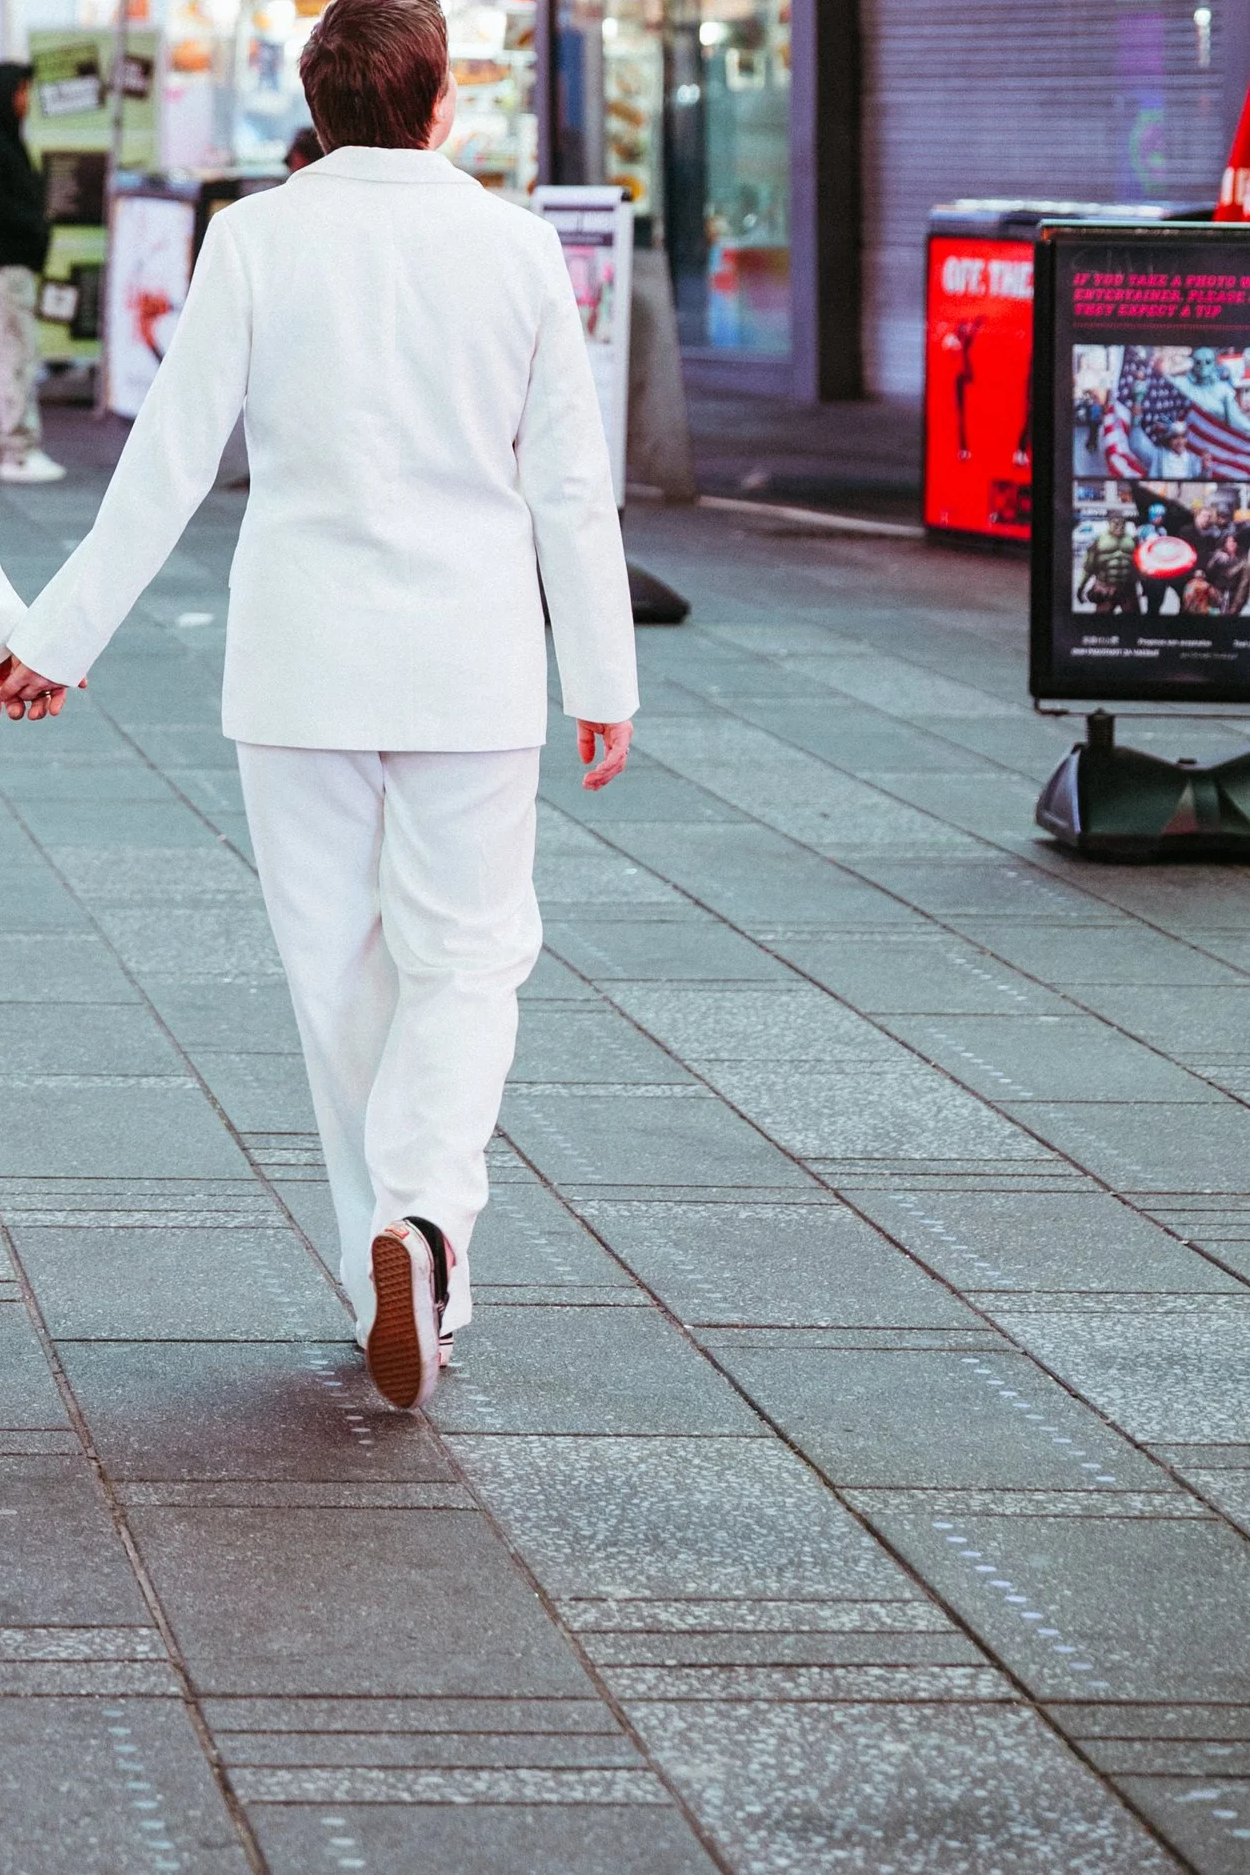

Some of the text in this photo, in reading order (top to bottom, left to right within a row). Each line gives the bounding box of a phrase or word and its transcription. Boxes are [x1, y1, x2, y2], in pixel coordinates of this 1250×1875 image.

[1072, 272, 1090, 286] IF
[1093, 272, 1125, 286] YOU
[1128, 273, 1168, 287] TAKE
[1170, 273, 1182, 288] A
[1184, 274, 1236, 289] PHOTO
[1186, 289, 1246, 304] PLEASE
[1074, 302, 1222, 318] THEY EXPECT A TIP
